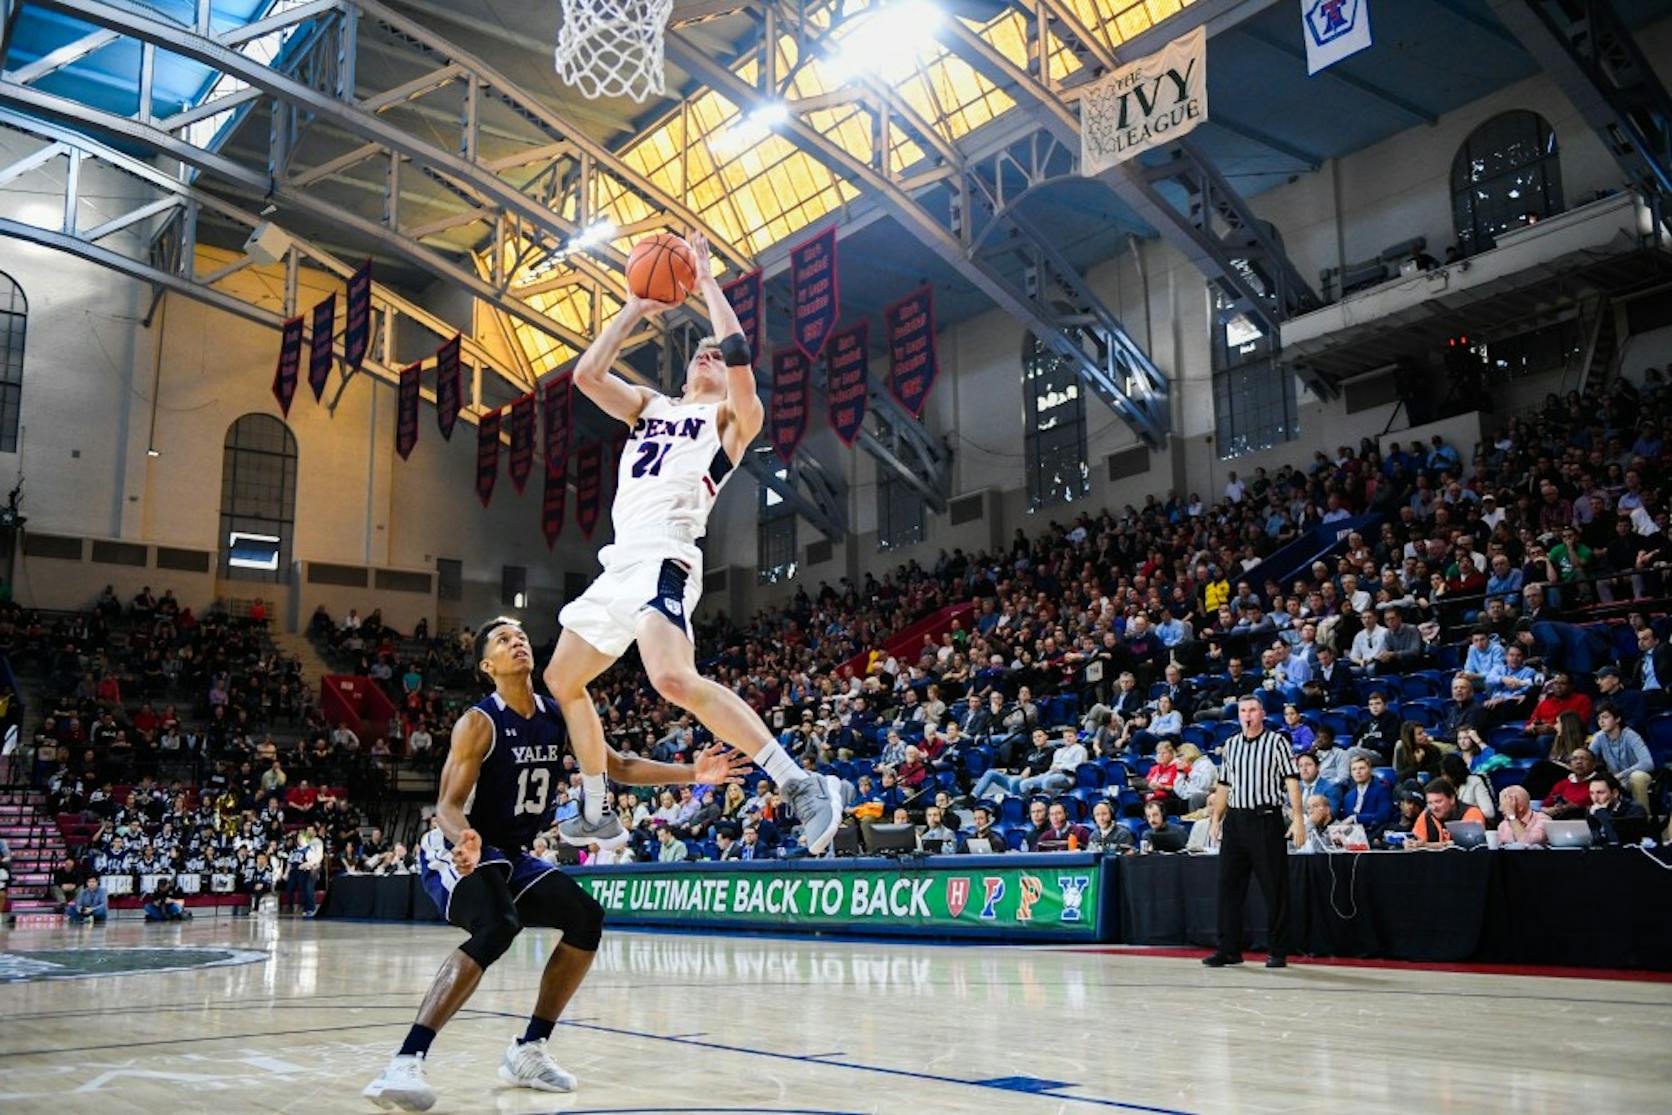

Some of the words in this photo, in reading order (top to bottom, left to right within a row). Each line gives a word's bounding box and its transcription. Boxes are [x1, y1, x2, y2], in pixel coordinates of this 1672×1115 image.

[1114, 68, 1143, 91] THE
[1115, 58, 1196, 130] IVY
[1115, 98, 1200, 152] LEAGUE
[629, 417, 706, 440] PENN
[631, 441, 673, 478] 21
[511, 744, 559, 764] YALE
[514, 768, 550, 816] 13
[591, 879, 627, 909] THE
[630, 878, 729, 912] ULTIMATE
[733, 879, 802, 914] BACK
[808, 878, 845, 916] TO
[850, 877, 933, 917] BACK
[951, 880, 964, 907] H
[980, 877, 1006, 920] P
[1016, 877, 1043, 920] P
